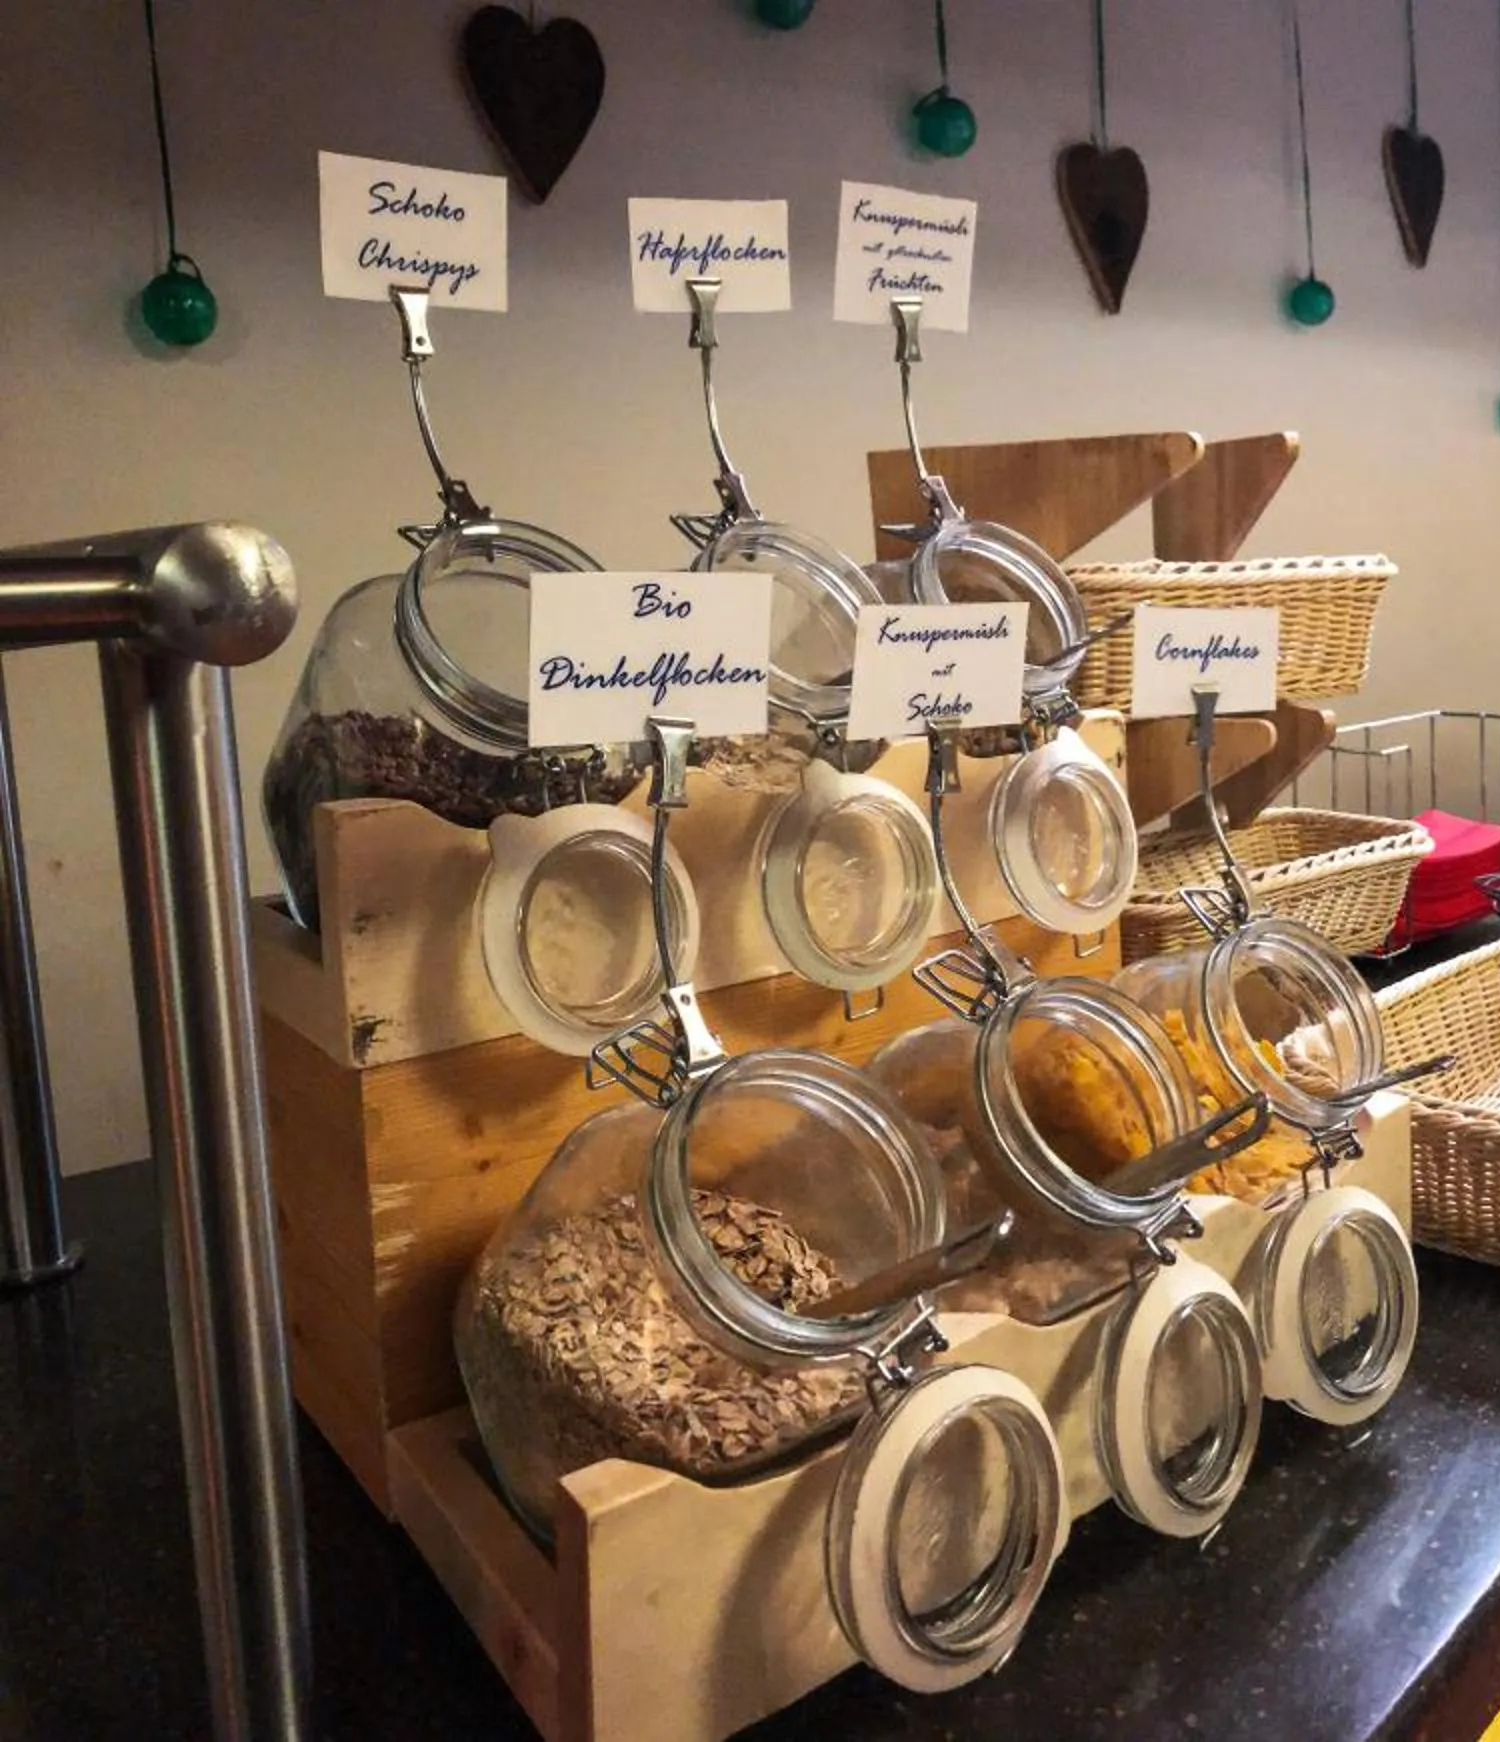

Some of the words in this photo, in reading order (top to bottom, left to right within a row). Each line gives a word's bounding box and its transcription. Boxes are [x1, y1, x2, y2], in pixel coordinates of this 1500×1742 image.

[368, 181, 466, 222] Schoko
[358, 238, 481, 296] Chrispys
[632, 583, 692, 619] Bio
[931, 663, 957, 677] mit
[1155, 632, 1260, 673] Cornflakes
[539, 651, 767, 707] Dinkelflocken
[906, 693, 973, 721] Schoko
